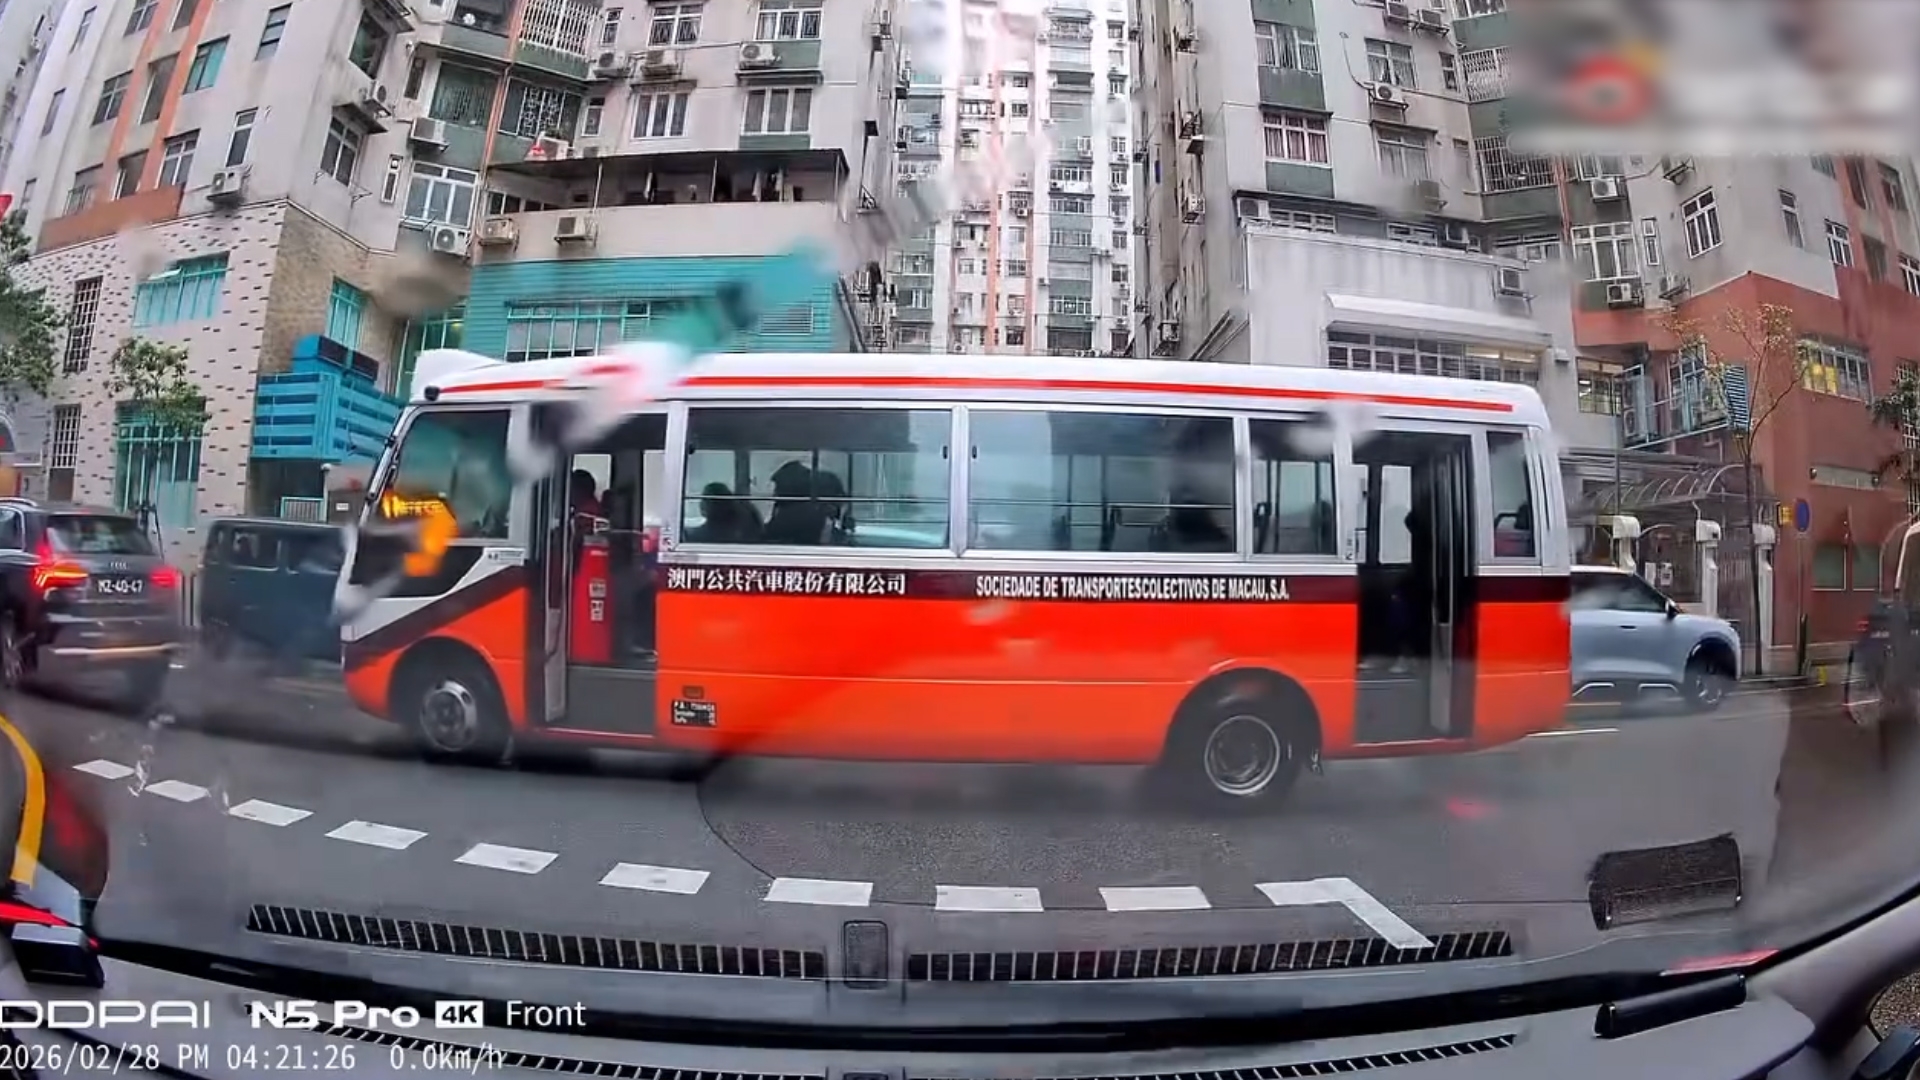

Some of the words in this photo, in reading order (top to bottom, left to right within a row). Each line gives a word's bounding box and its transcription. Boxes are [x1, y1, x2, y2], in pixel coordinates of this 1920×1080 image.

[667, 568, 906, 594] 澳門公共汽車股份有限公司
[976, 575, 1040, 597] SOCIEDADE
[1043, 577, 1058, 597] DE
[1211, 578, 1226, 599] DE
[1271, 580, 1290, 600] S.A.
